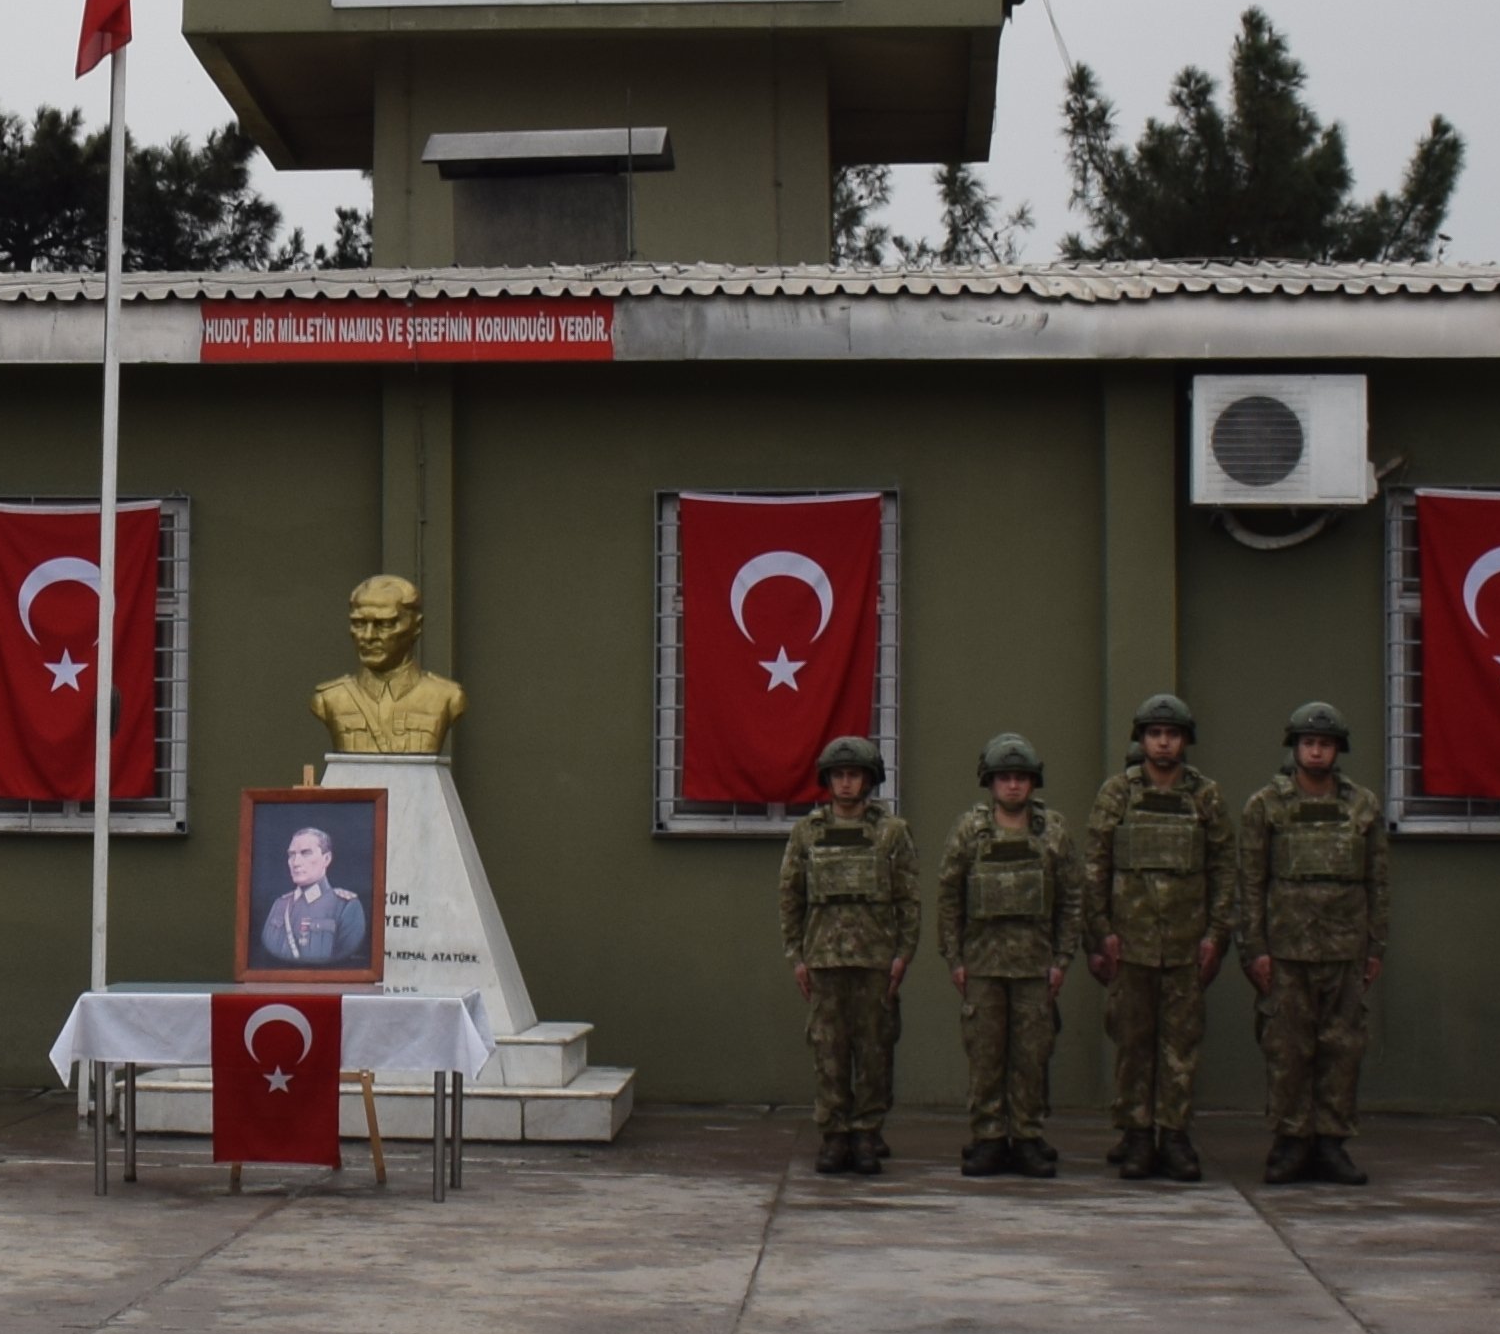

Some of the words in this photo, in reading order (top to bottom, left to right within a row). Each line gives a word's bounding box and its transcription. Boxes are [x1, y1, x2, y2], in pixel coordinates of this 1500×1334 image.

[205, 318, 250, 349] HUDUT,
[253, 312, 275, 343] BİR
[278, 312, 336, 343] MİLLETİN
[338, 317, 384, 343] NAMUS
[386, 317, 403, 343] VE
[406, 311, 472, 349] ŞEREFİNİN
[475, 311, 555, 343] KORUNDUĞU
[558, 311, 609, 342] YERDİR.
